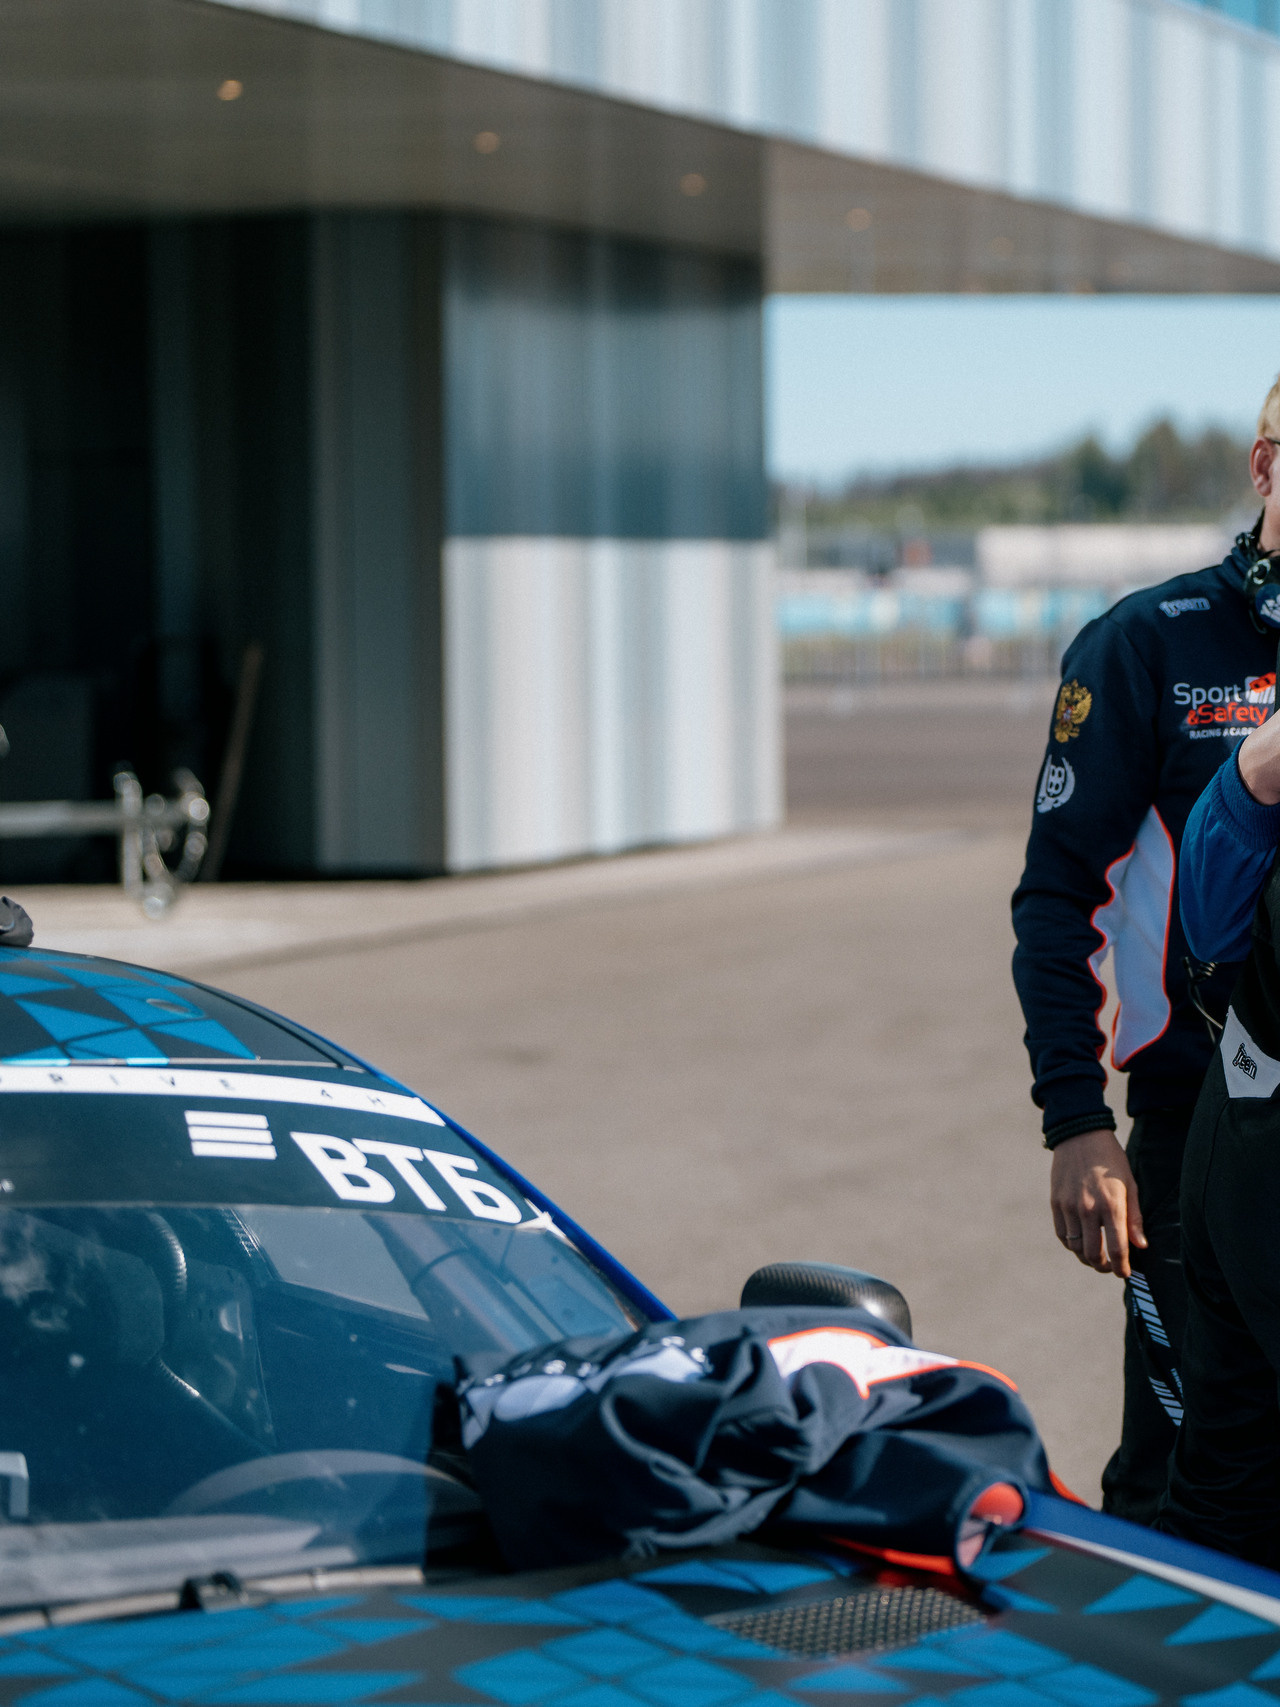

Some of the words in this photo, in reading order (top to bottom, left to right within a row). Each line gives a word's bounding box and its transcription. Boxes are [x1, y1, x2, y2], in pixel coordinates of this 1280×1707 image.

[1173, 683, 1242, 709] Sport
[1187, 702, 1268, 726] &Safety
[1189, 728, 1221, 740] RACING
[289, 1131, 522, 1224] ВТБ
